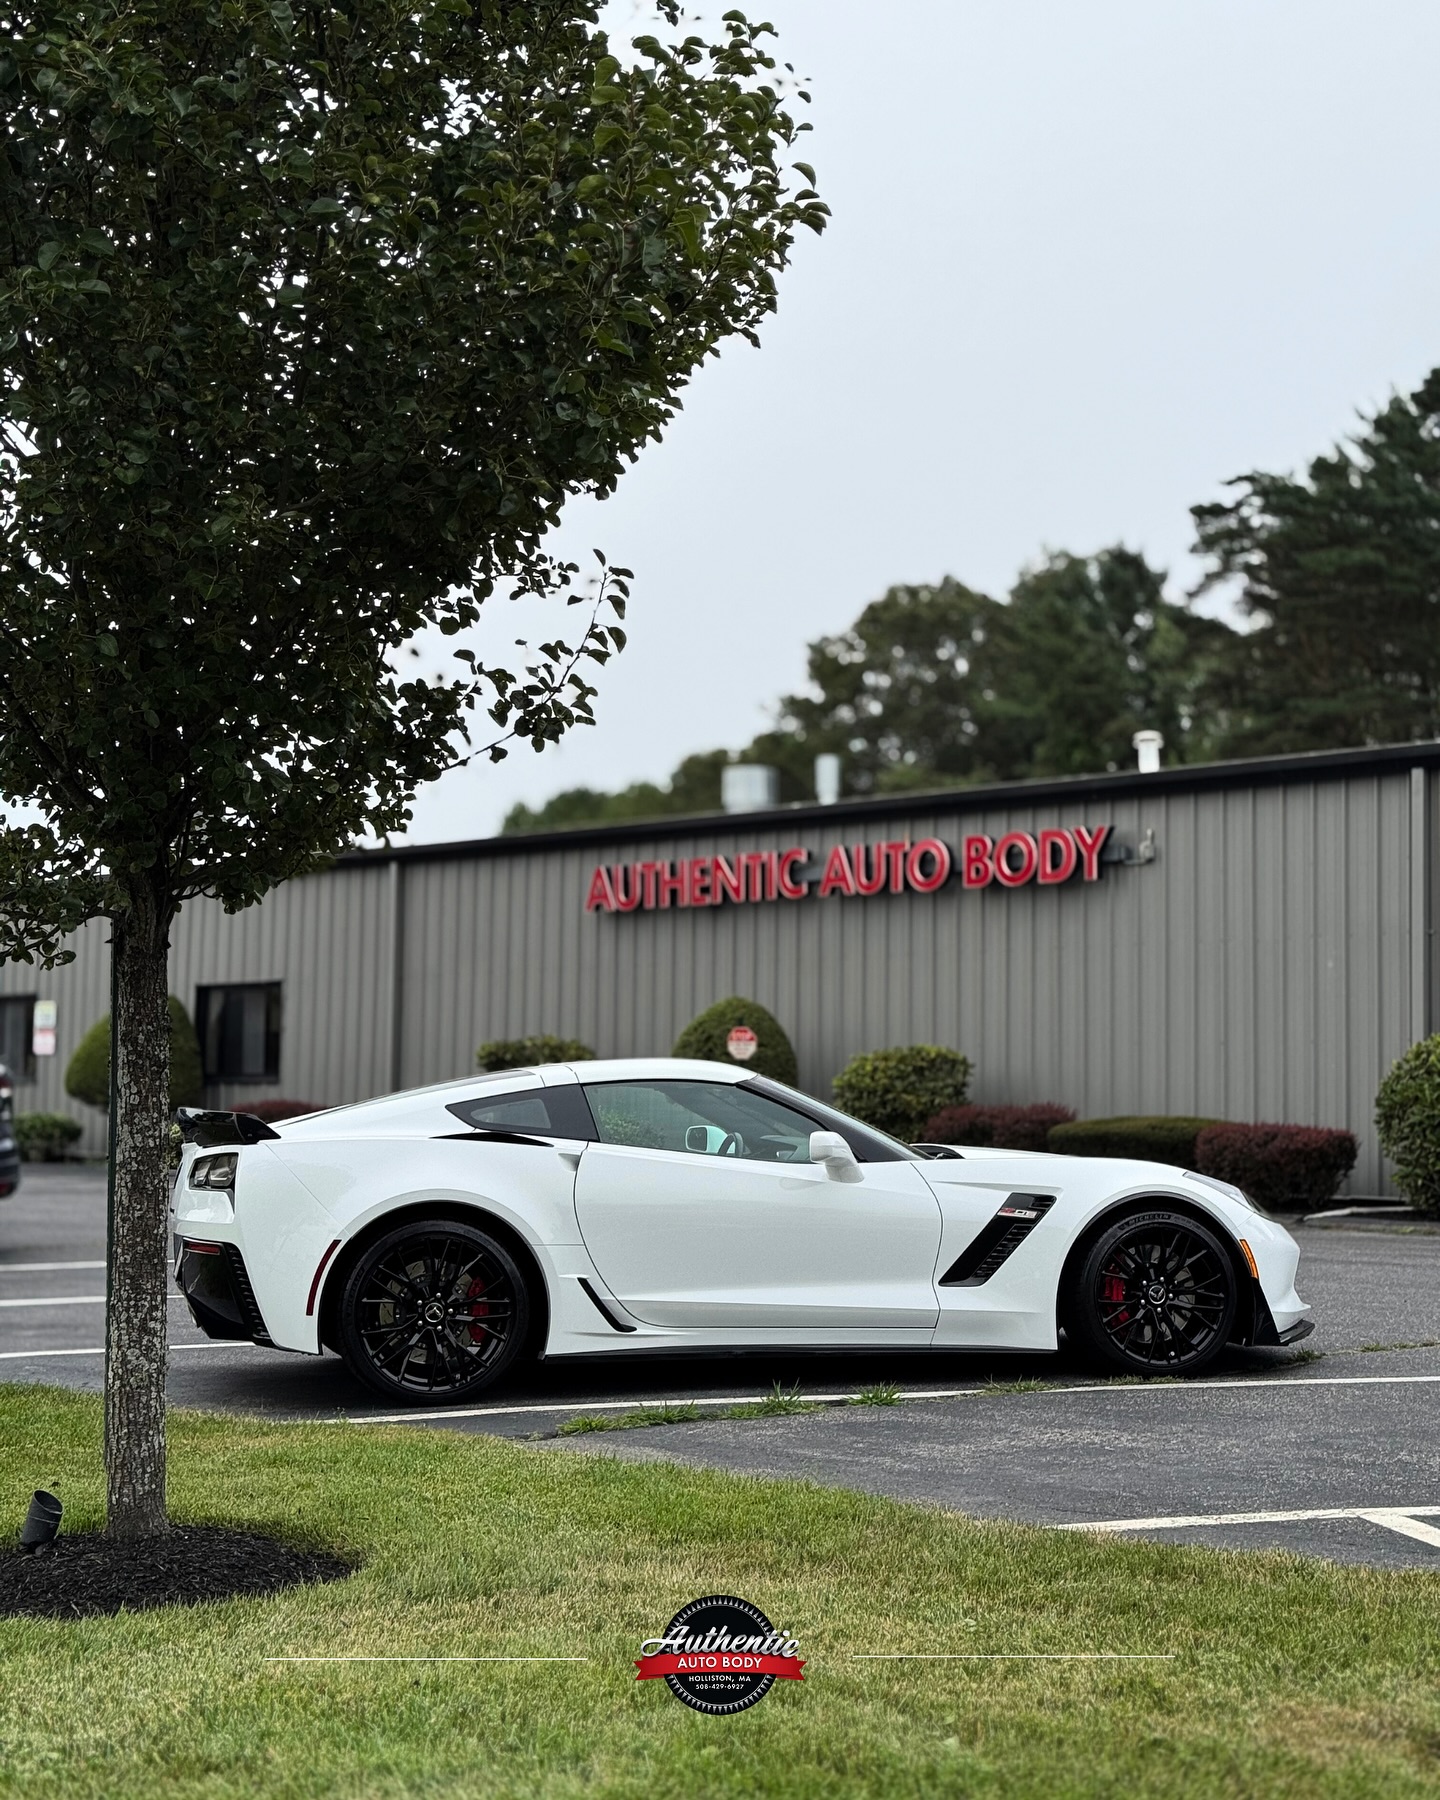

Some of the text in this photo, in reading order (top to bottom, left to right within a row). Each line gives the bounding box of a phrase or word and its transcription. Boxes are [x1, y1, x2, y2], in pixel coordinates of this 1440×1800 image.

[586, 825, 1110, 913] AUTHENTIC AUTO BODY
